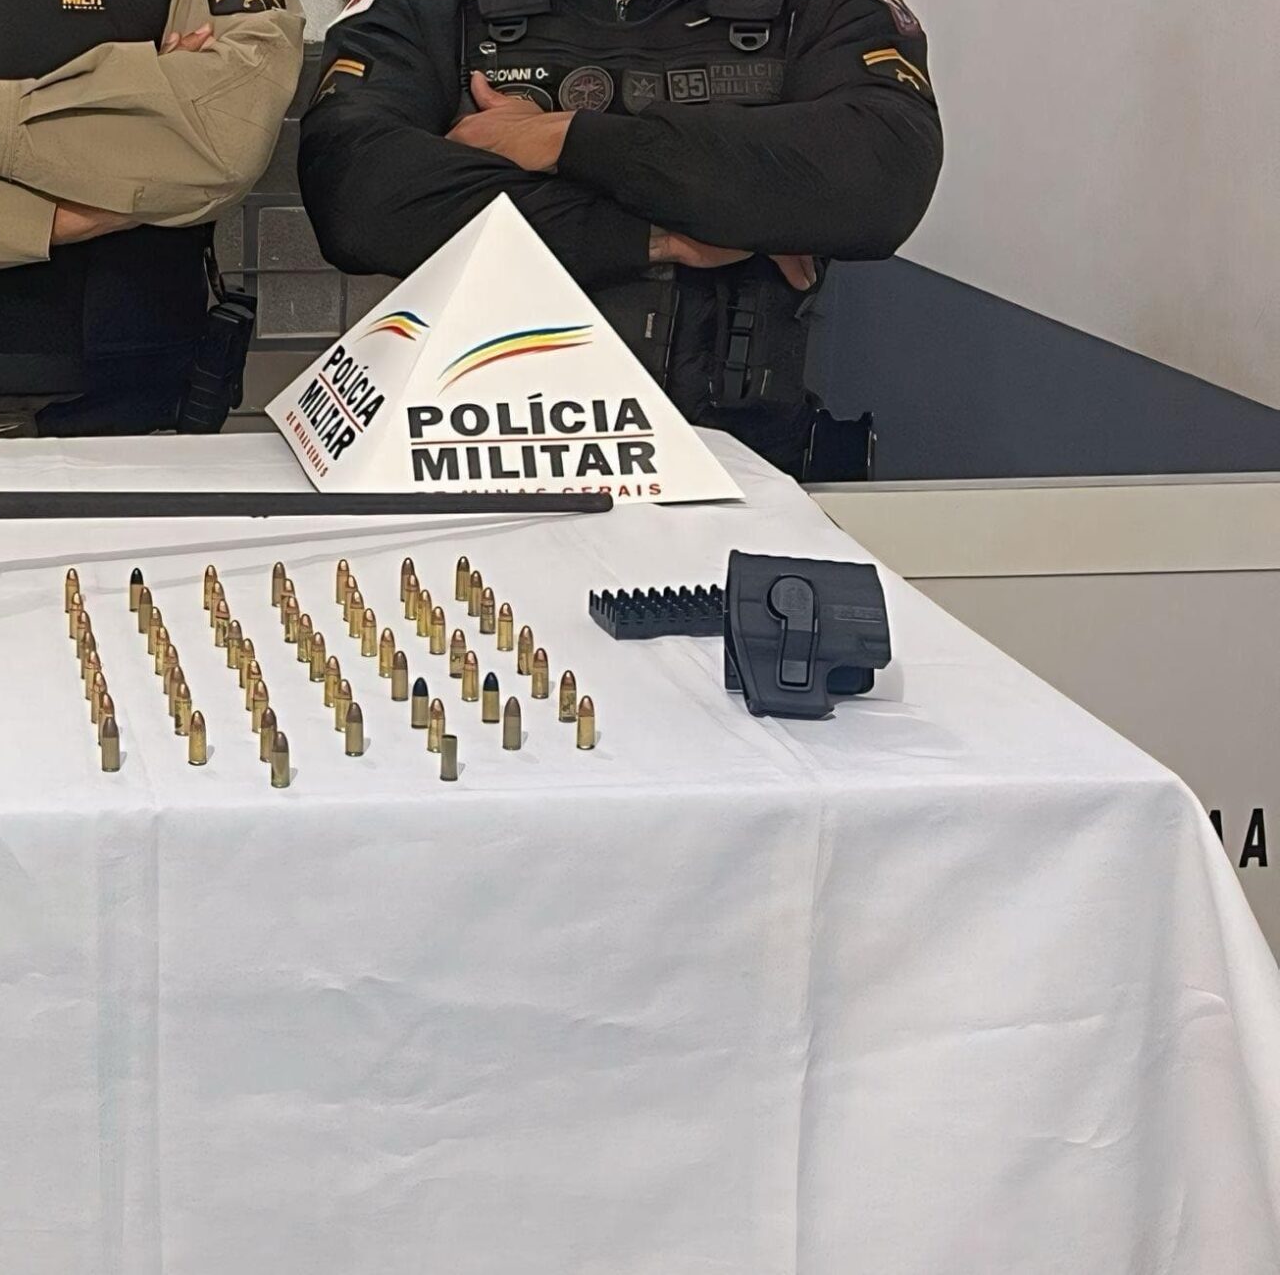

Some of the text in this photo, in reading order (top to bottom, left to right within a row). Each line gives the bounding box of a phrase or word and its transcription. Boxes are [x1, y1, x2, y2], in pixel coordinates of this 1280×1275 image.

[671, 74, 705, 99] 35
[322, 344, 385, 428] POLÍCIA
[297, 378, 356, 461] MILITAR
[407, 392, 653, 439] POLÍCIA
[411, 441, 658, 482] MILITAR
